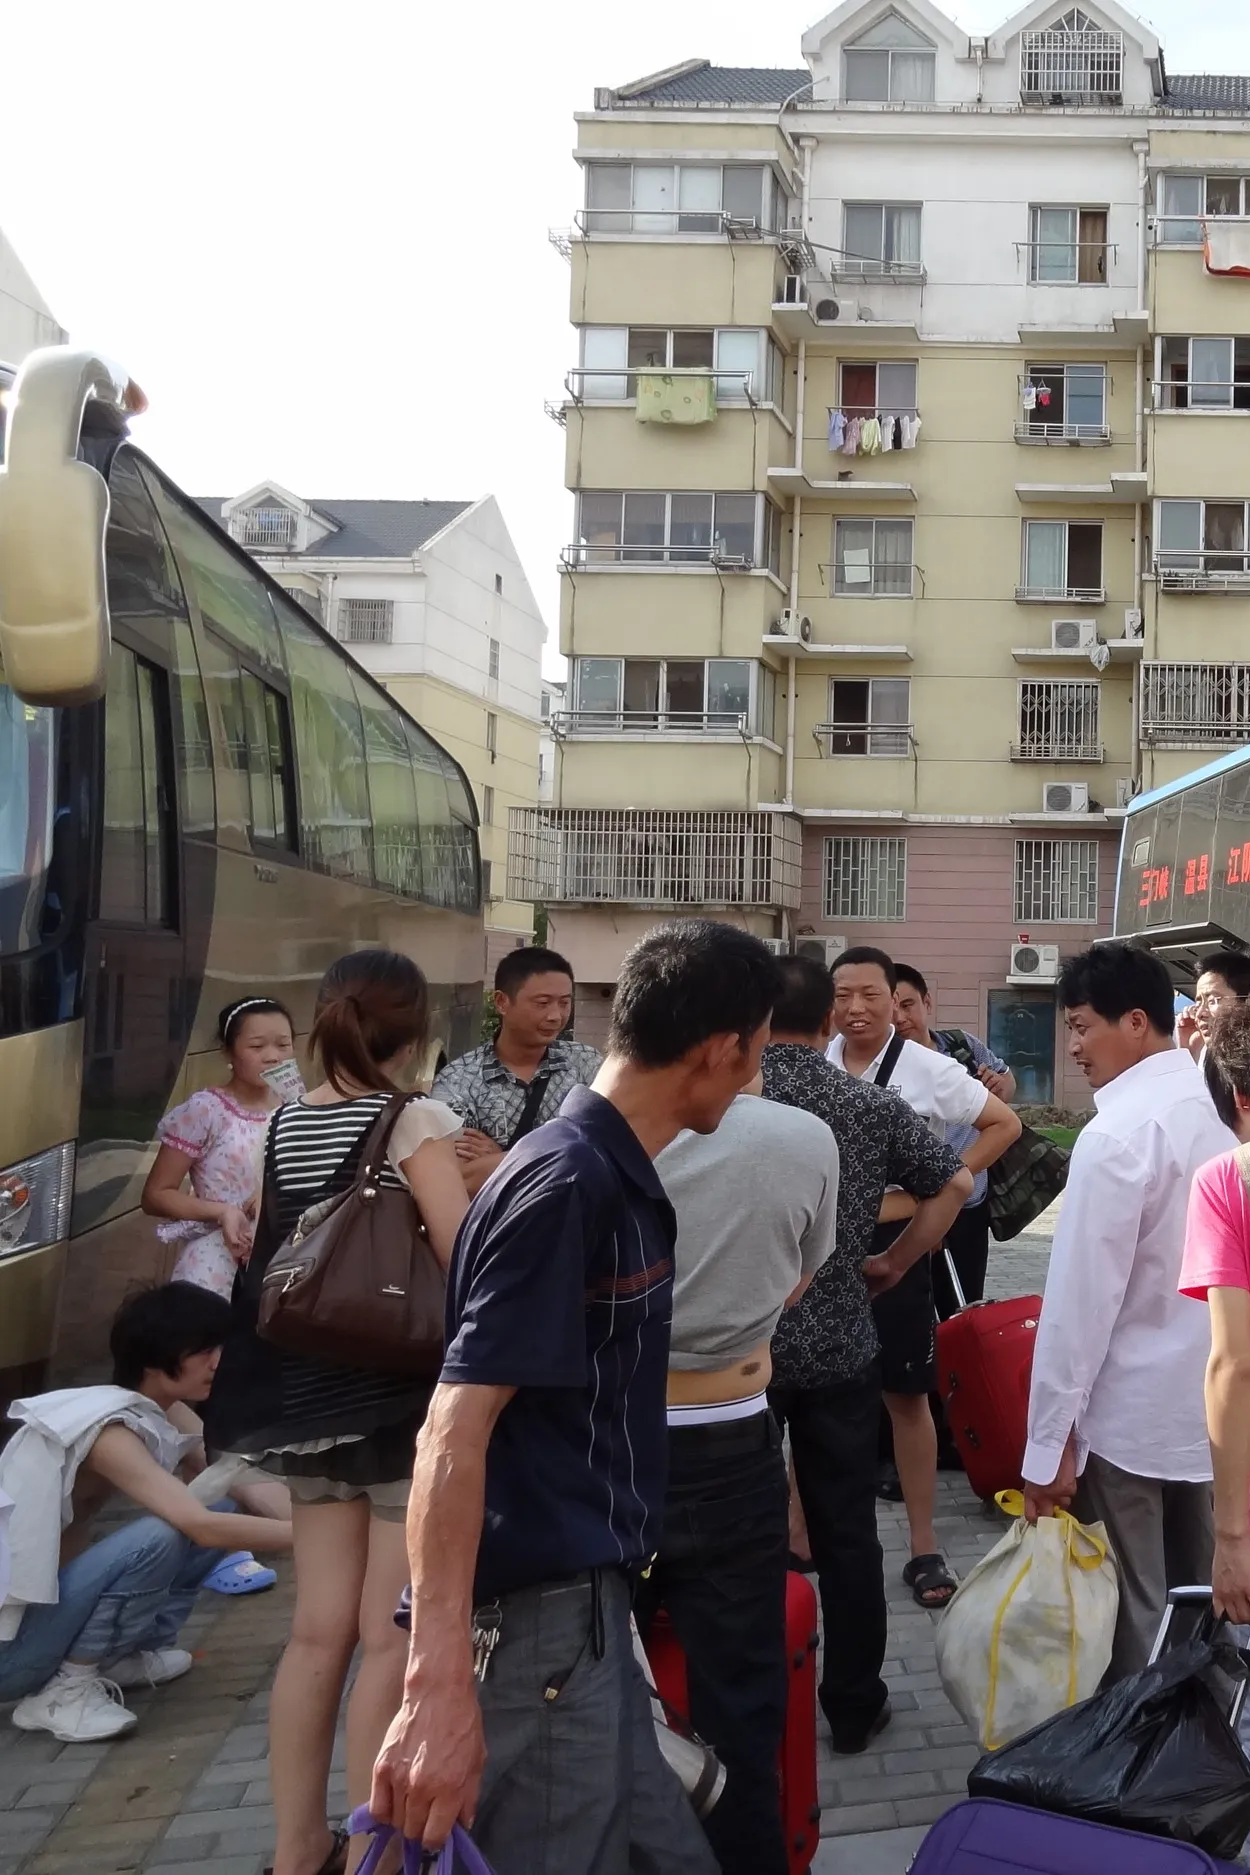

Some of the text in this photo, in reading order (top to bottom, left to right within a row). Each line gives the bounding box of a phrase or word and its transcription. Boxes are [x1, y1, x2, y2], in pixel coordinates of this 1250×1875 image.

[1140, 866, 1169, 906] 三门峡
[1184, 854, 1209, 895] 温县
